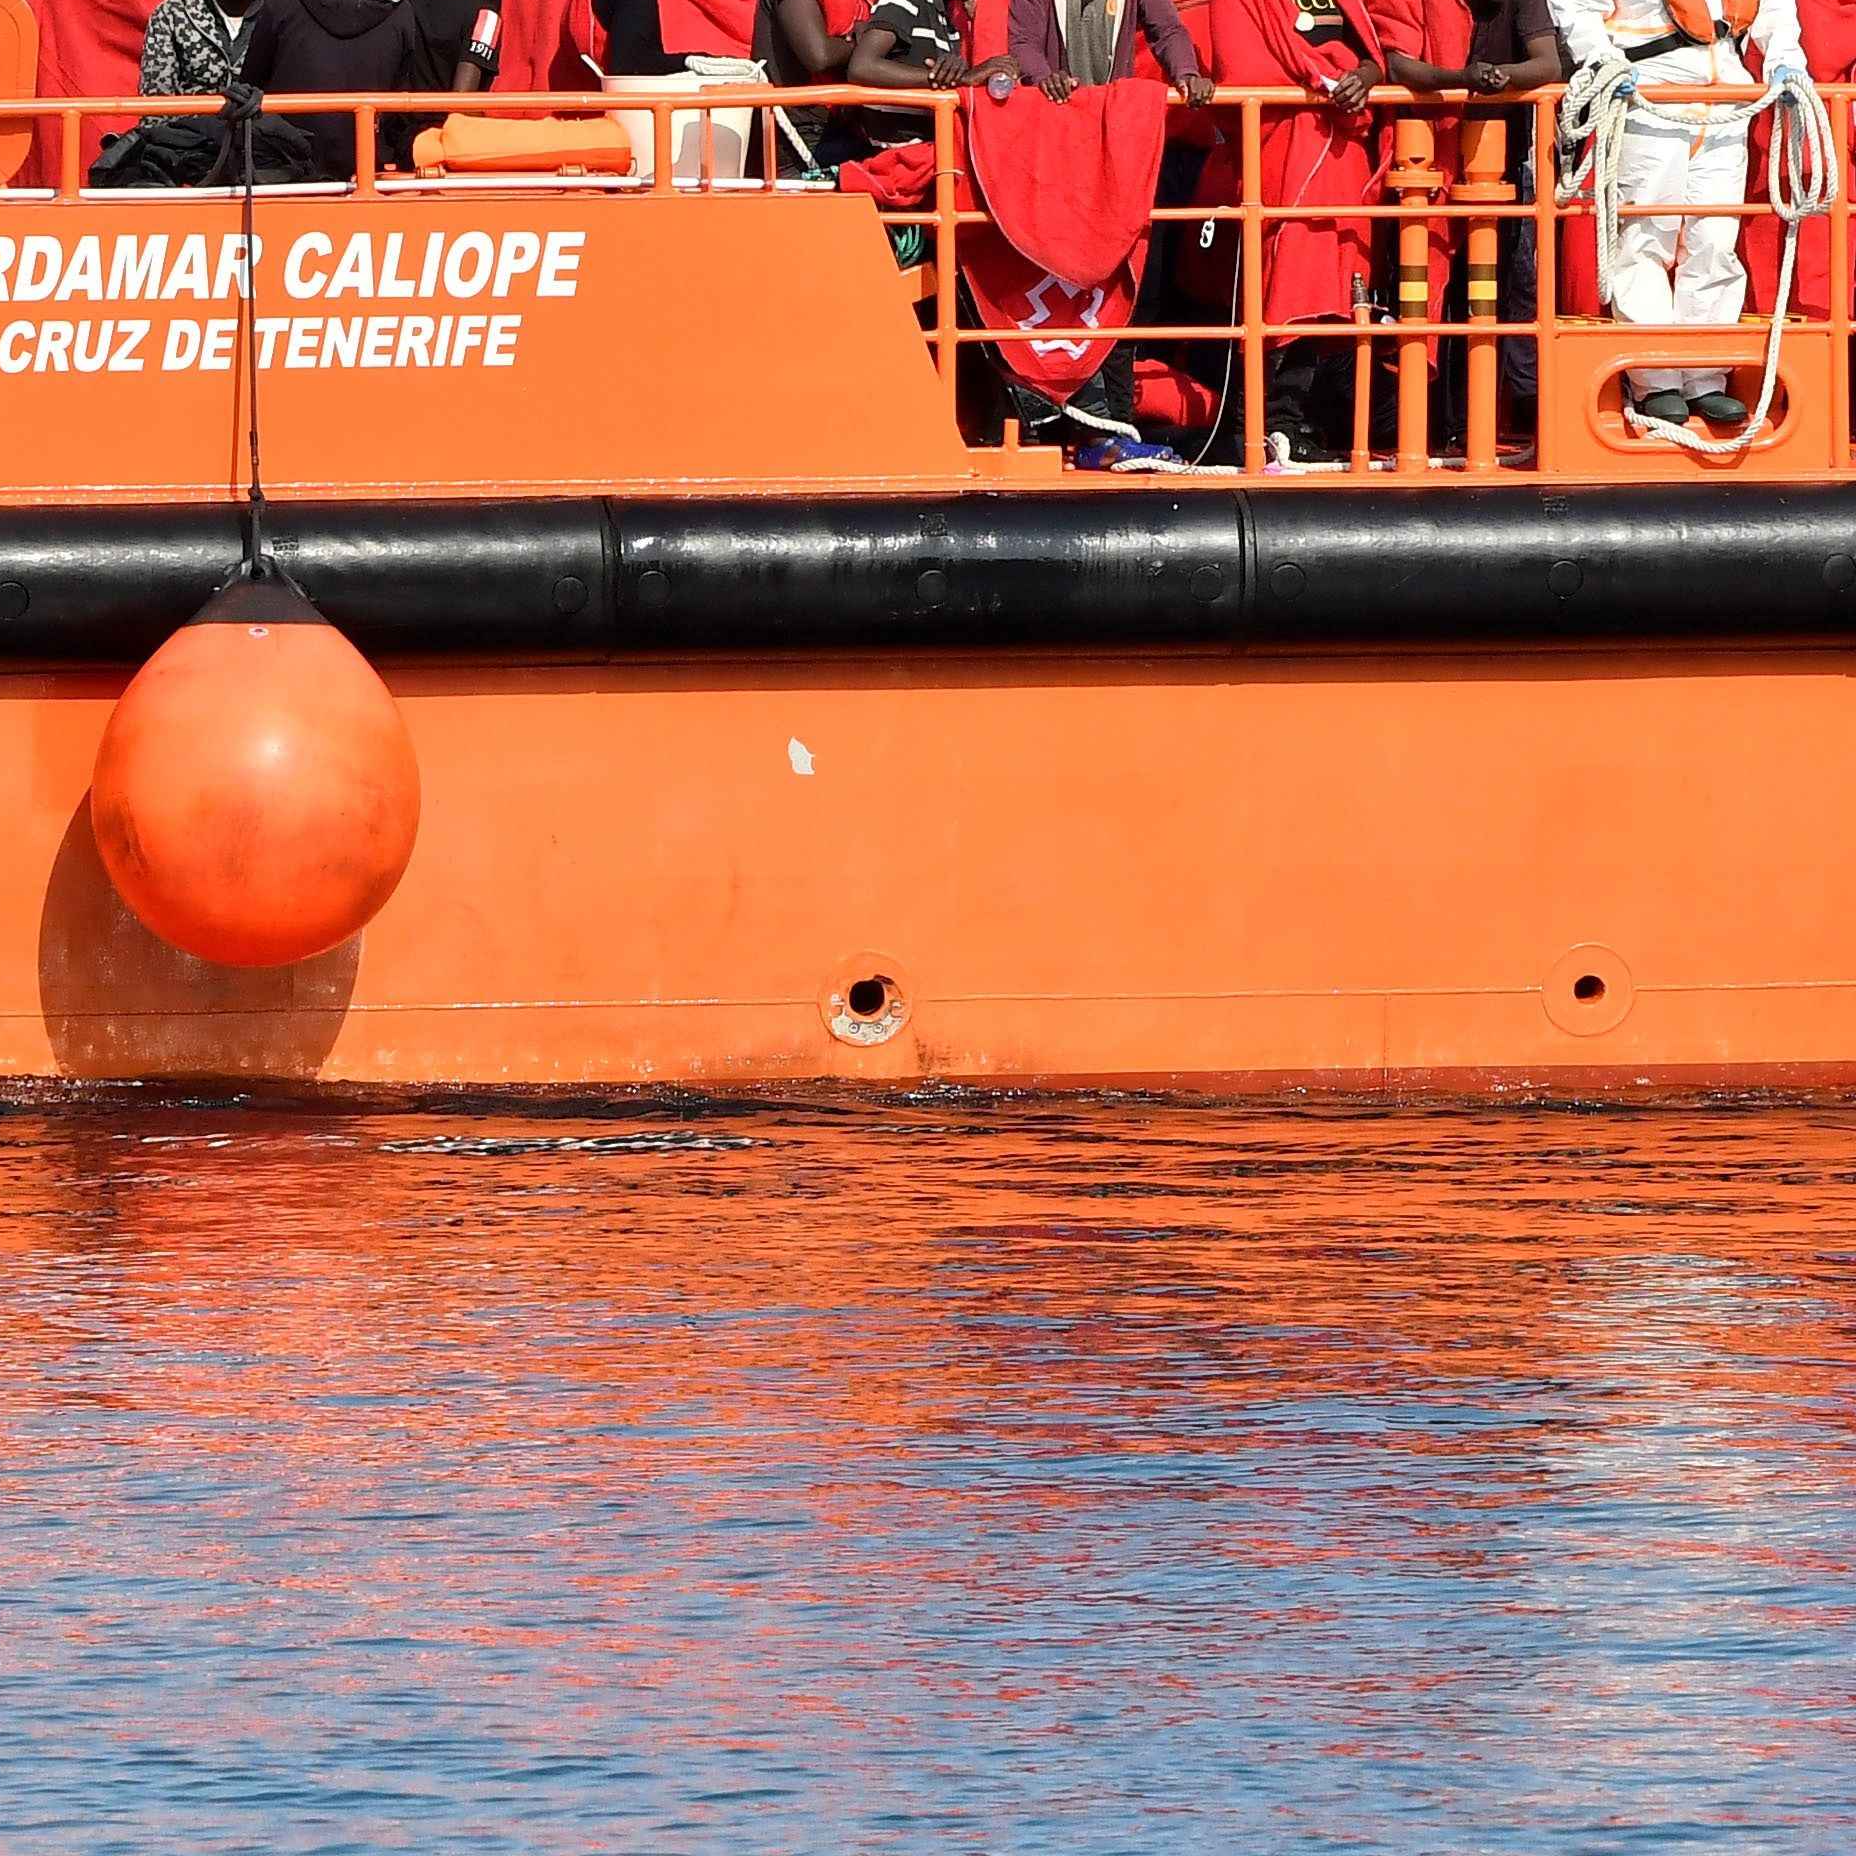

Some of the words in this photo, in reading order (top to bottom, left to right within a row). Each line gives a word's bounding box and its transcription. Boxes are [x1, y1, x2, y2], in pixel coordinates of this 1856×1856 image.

[469, 41, 493, 61] 1911
[283, 231, 586, 300] CALIOPE
[161, 318, 239, 371] DE
[254, 314, 522, 369] TENERIFE
